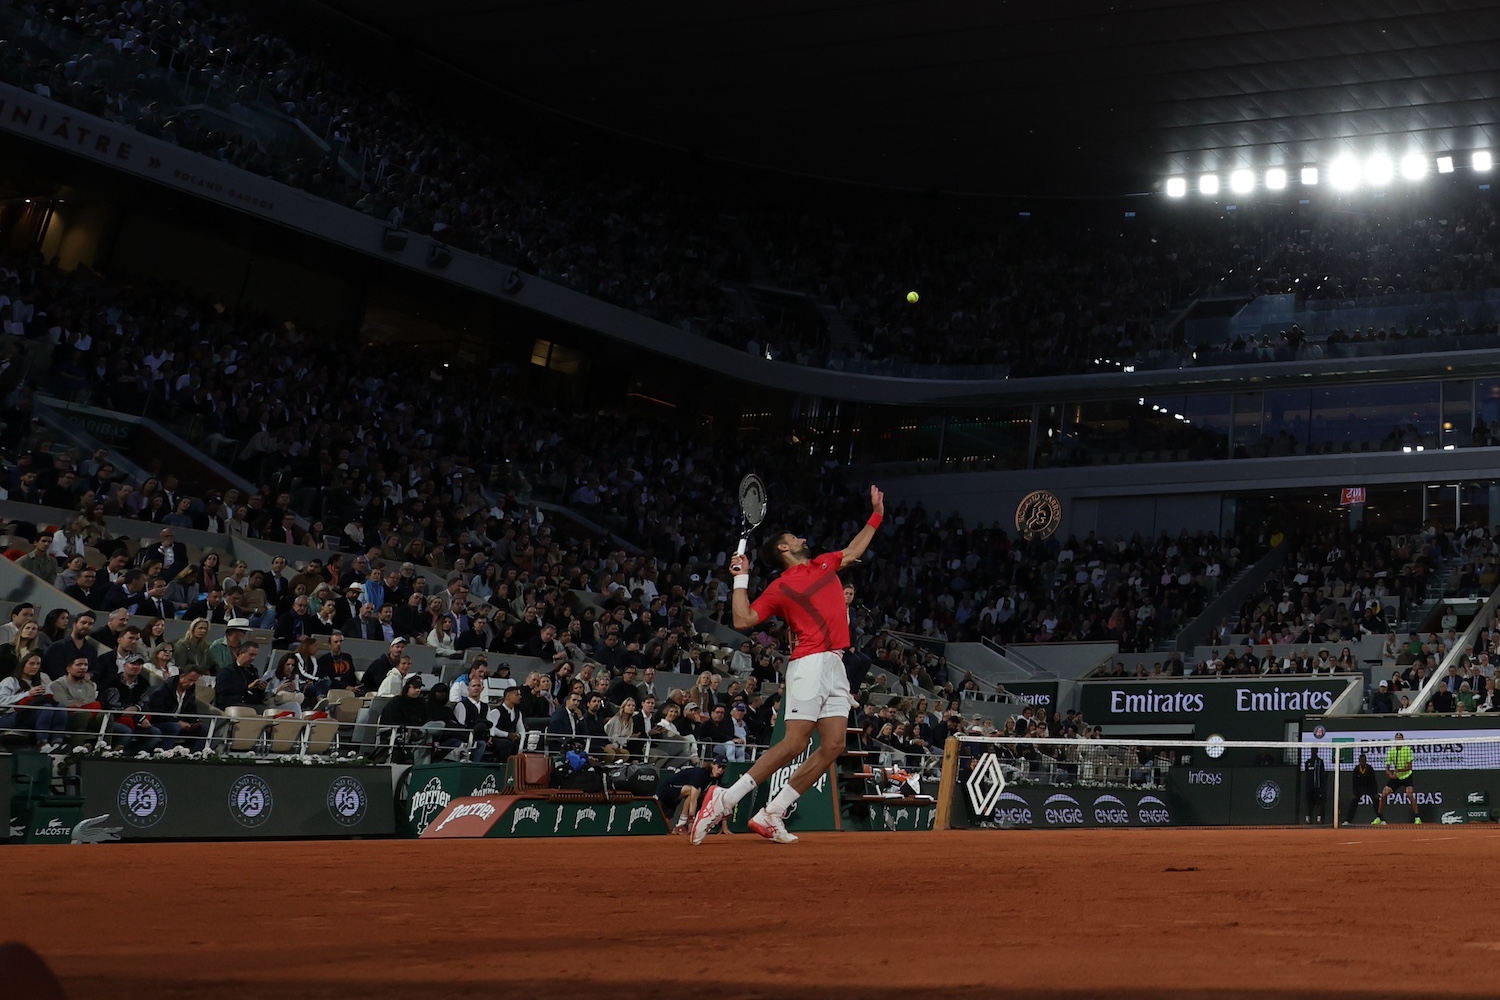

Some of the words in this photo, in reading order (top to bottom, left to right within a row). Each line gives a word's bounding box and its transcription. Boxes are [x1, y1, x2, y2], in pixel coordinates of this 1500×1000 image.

[1110, 688, 1205, 713] Emirates
[1236, 686, 1332, 712] Emirates
[637, 774, 655, 782] HEAD
[1188, 770, 1222, 785] Infosys
[120, 775, 142, 806] ROLAND
[143, 775, 165, 807] GARROS
[435, 800, 496, 832] perrier
[511, 803, 540, 834] perrier
[574, 806, 597, 830] perrier
[627, 804, 652, 832] perrier
[35, 827, 71, 836] LACOSTE
